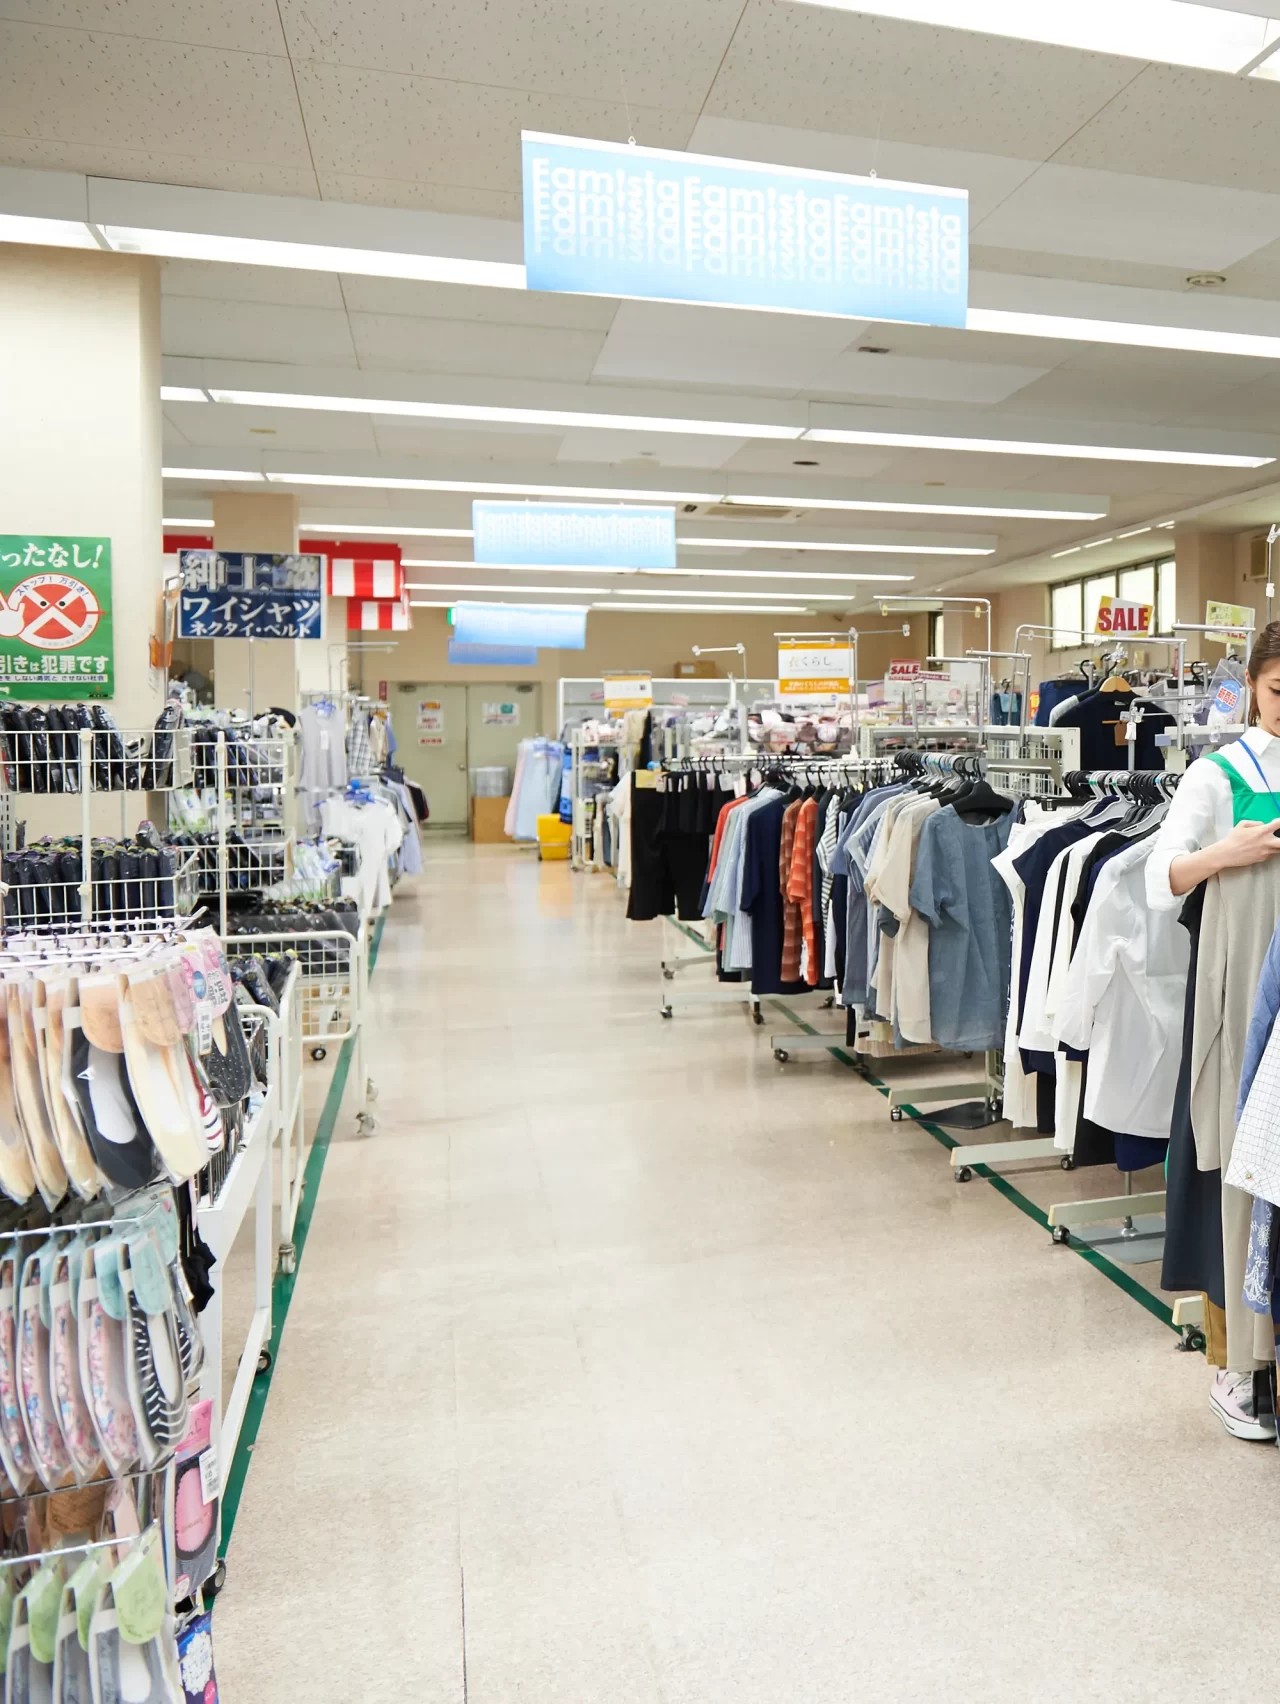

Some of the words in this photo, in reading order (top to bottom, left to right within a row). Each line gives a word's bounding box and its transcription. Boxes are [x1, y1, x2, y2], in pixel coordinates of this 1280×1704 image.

[183, 597, 320, 623] ワイシャツ
[1098, 607, 1149, 632] SALE
[189, 621, 312, 637] ネクタイ・ベルト
[0, 654, 109, 674] 引きは犯罪です
[890, 664, 920, 675] SALE
[1216, 684, 1239, 708] 新商品
